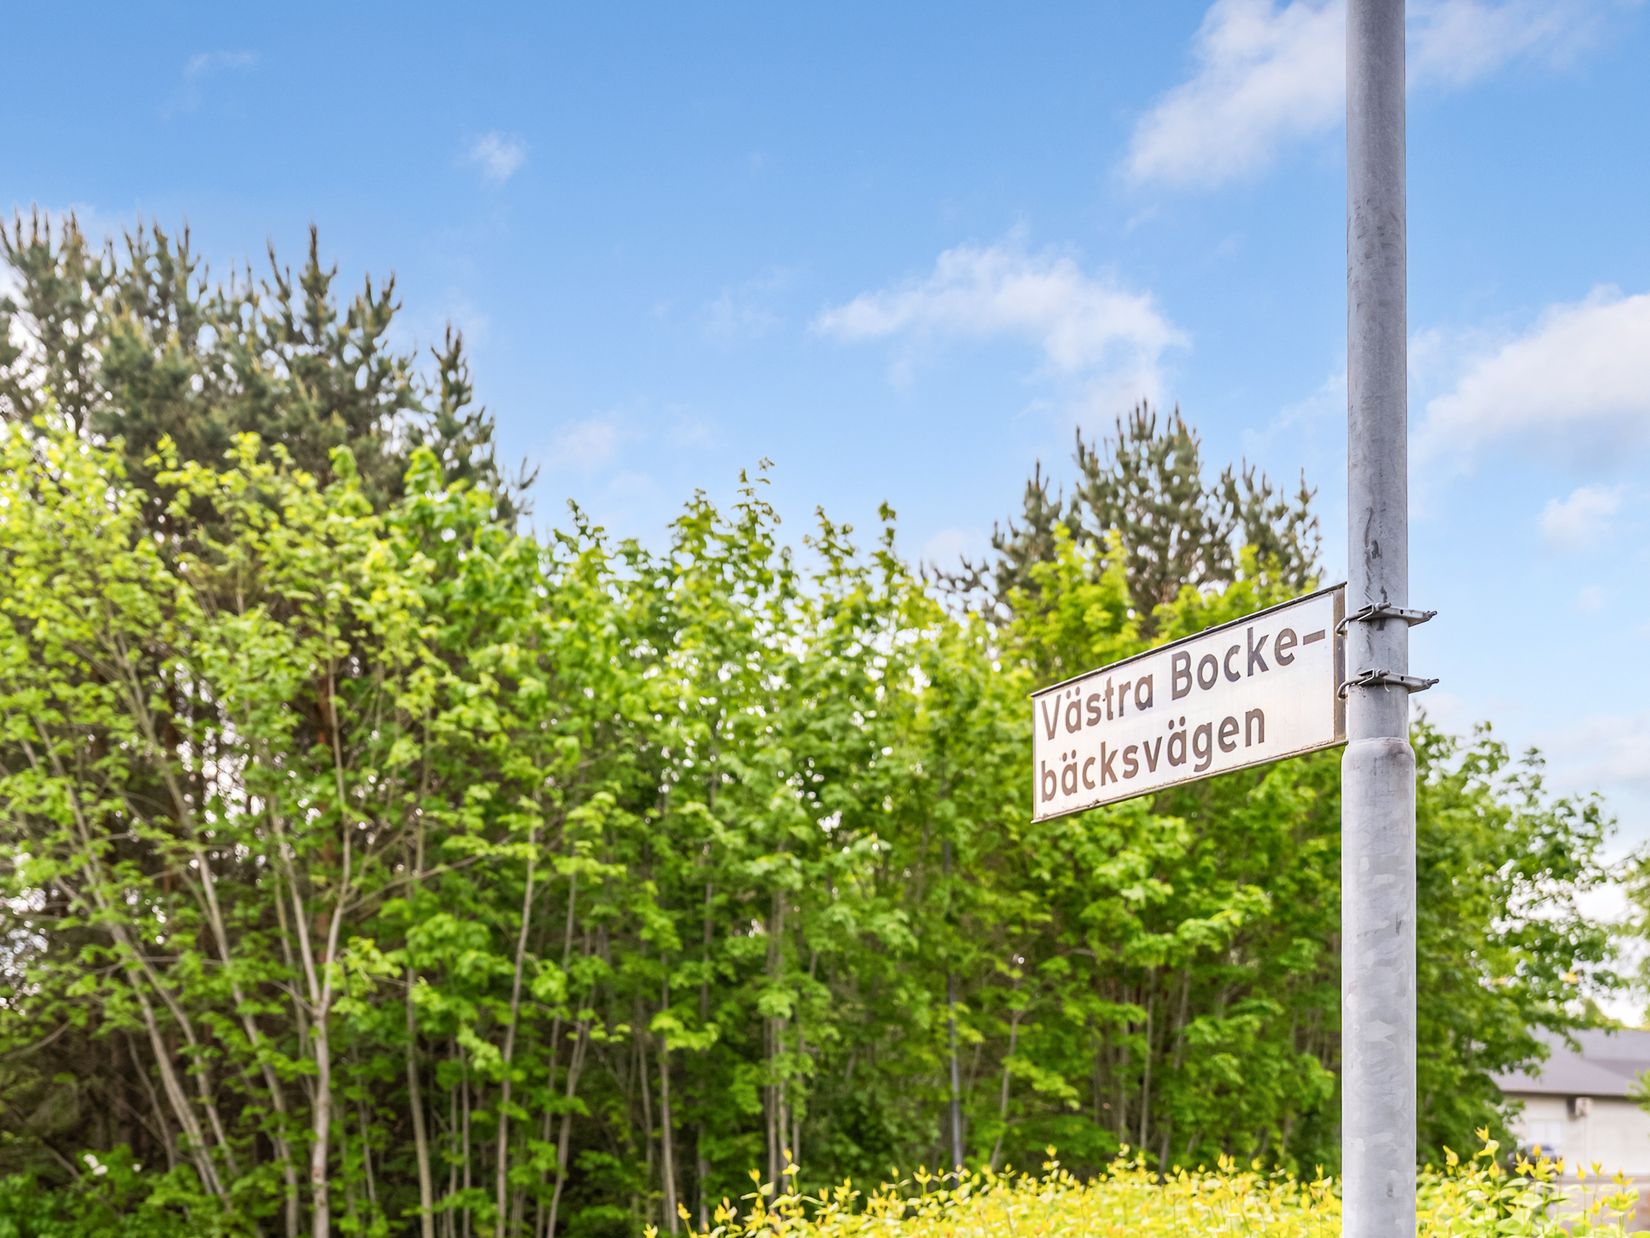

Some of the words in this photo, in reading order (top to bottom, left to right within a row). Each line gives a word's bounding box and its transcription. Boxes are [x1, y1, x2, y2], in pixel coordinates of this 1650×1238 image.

[1041, 673, 1153, 740] Västra
[1171, 627, 1326, 700] Bocke-
[1041, 707, 1265, 802] bäcksvägen
